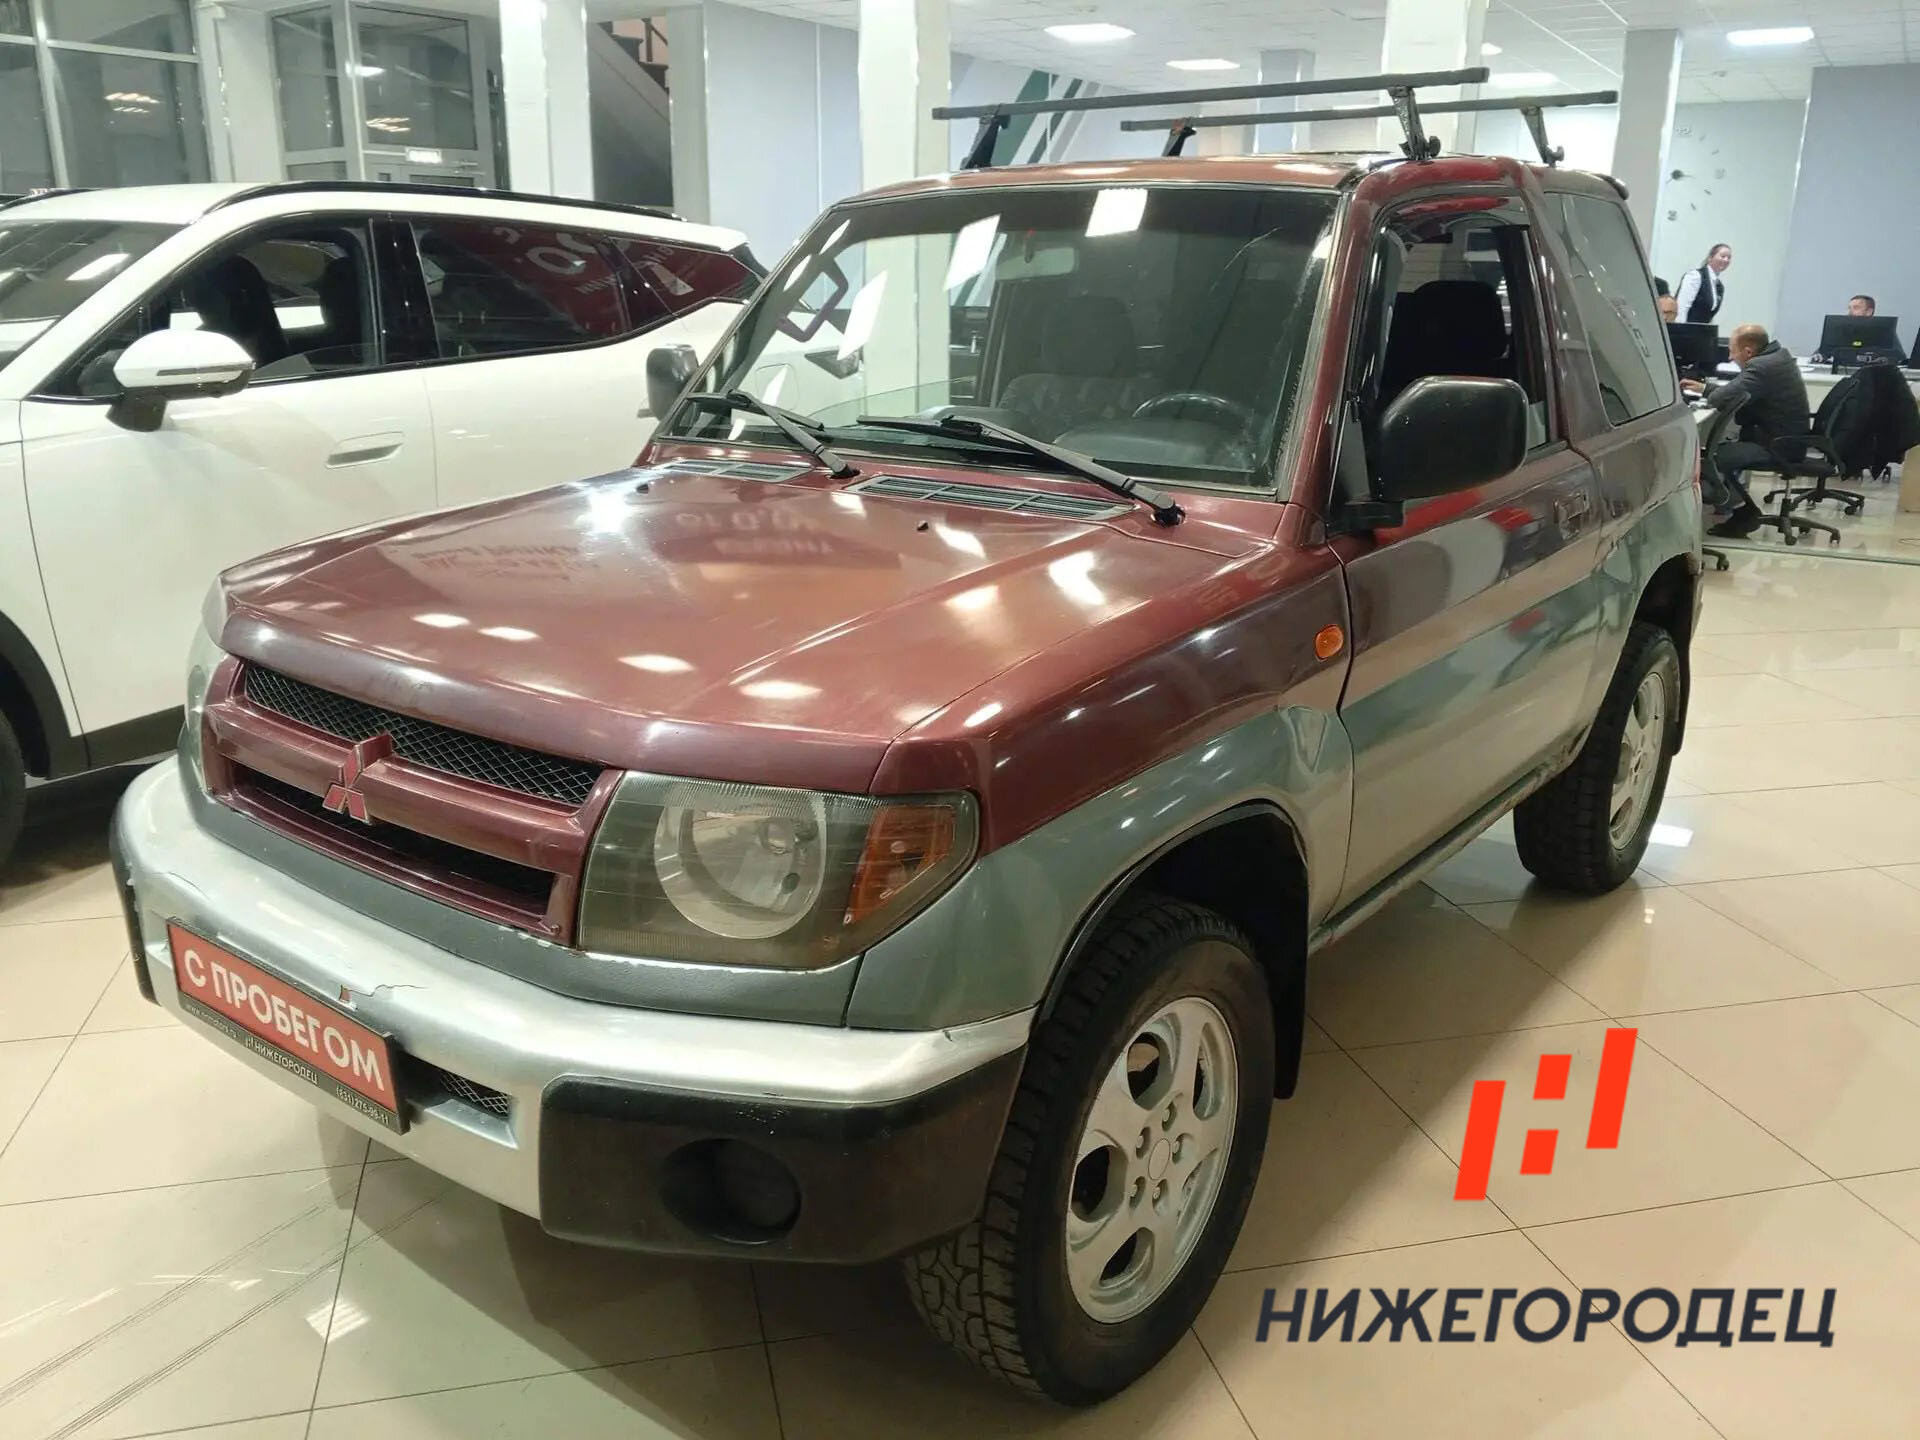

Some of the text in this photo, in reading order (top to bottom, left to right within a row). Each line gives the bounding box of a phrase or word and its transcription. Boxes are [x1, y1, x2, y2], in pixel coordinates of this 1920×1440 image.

[184, 950, 206, 987] С
[212, 961, 385, 1091] ПРОБЕГОМ
[255, 1040, 318, 1084] НИЖЕГОРОДЕЦ
